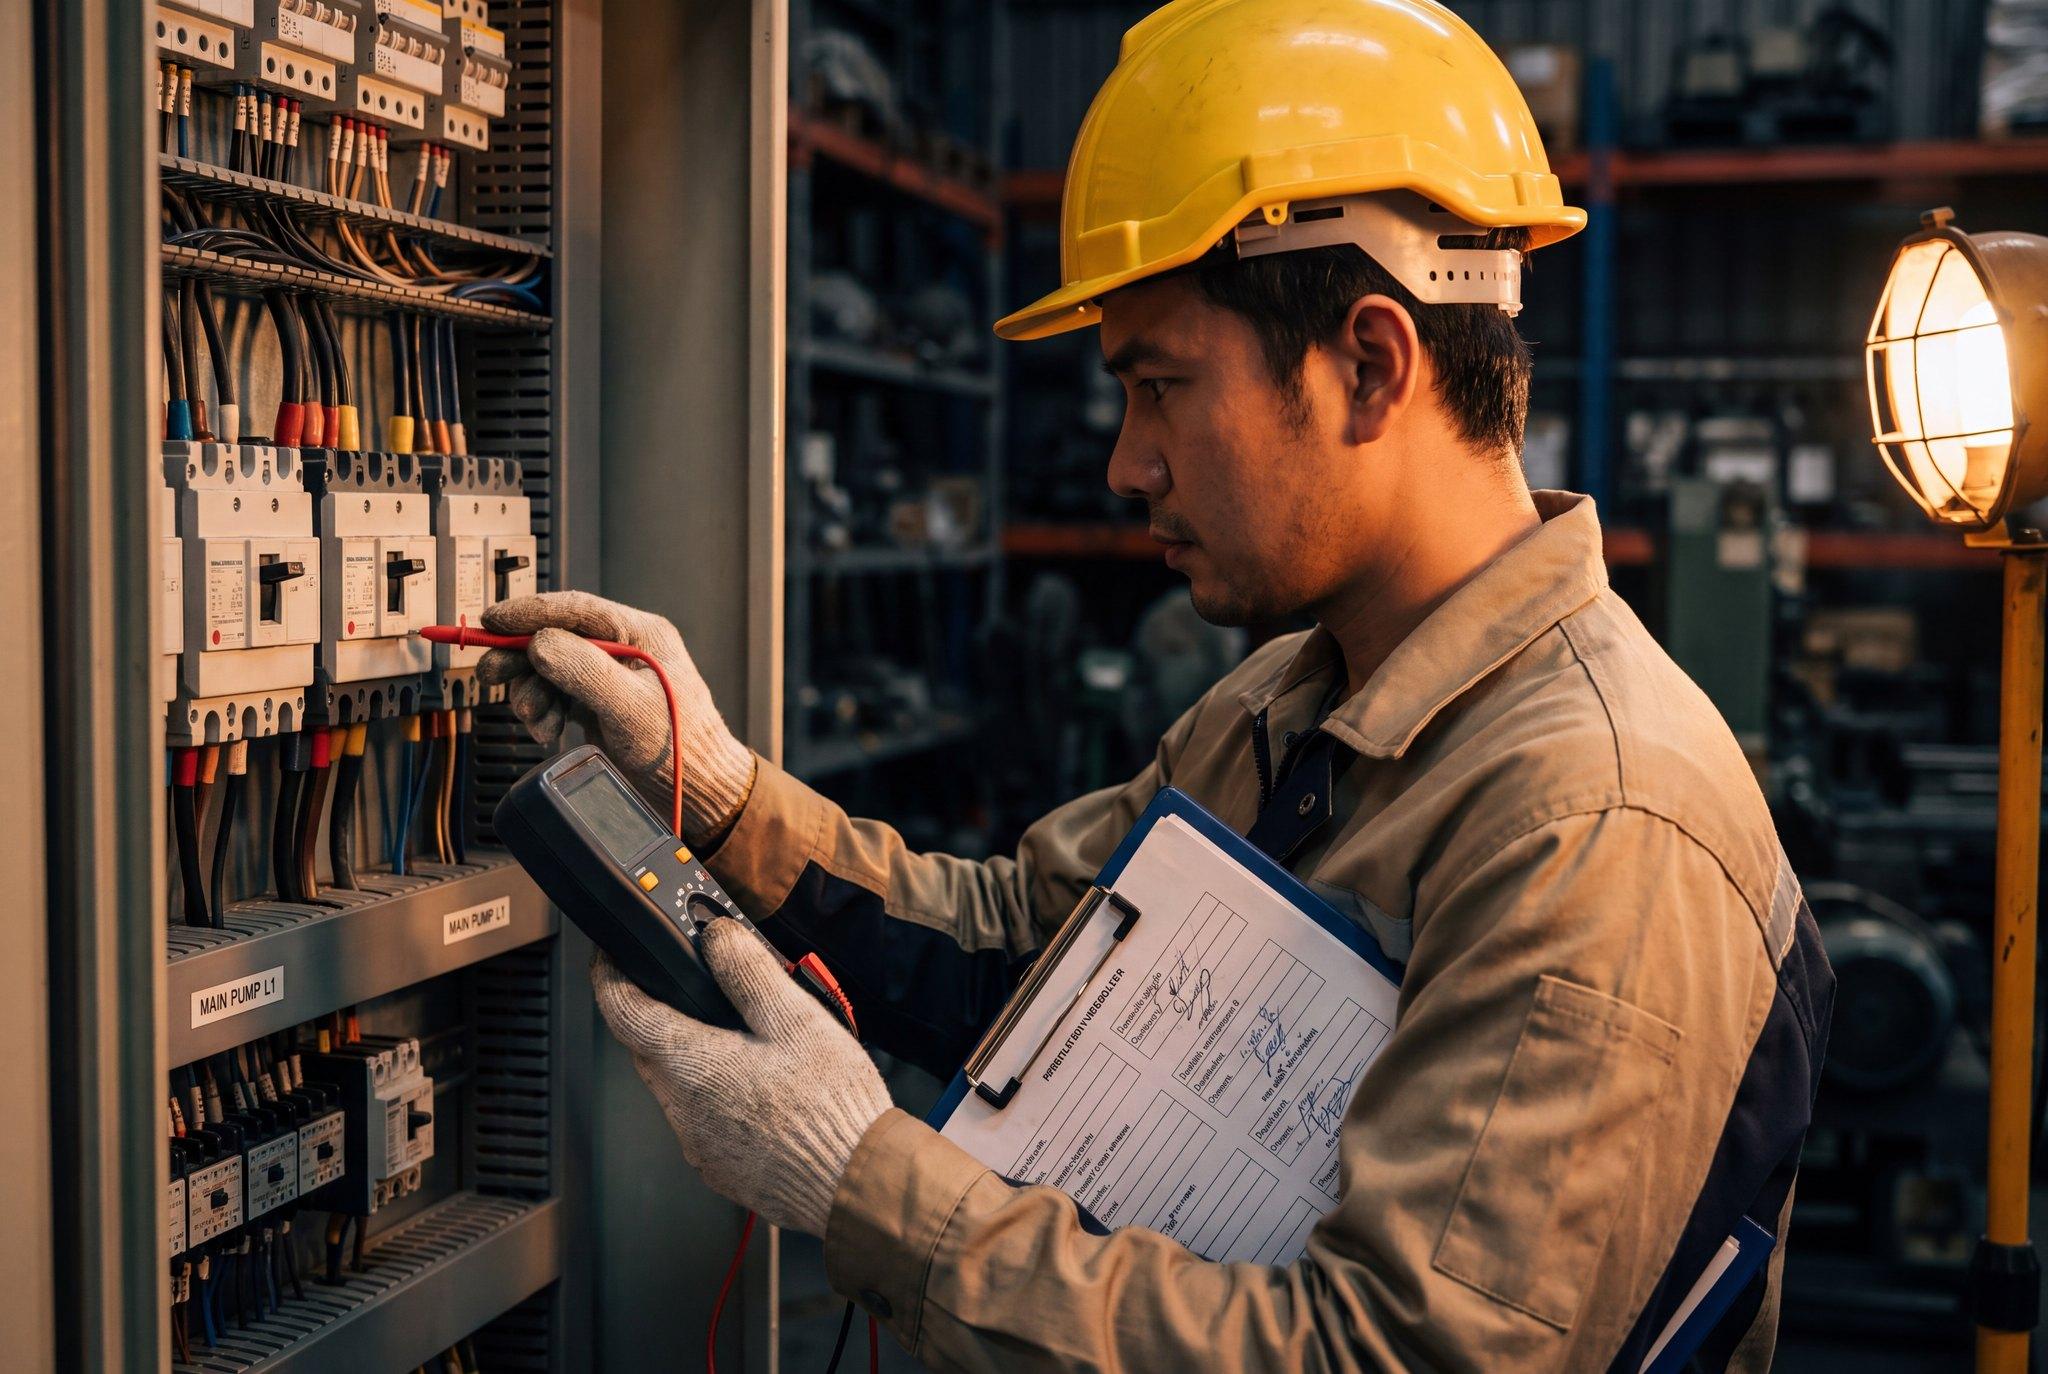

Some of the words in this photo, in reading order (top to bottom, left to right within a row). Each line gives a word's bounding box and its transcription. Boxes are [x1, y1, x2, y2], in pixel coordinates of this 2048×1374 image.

[449, 915, 469, 935] MAIN
[471, 909, 494, 928] PUMP
[496, 905, 504, 921] L1
[200, 992, 227, 1016] MAIN
[230, 982, 261, 1006] PUMP
[264, 977, 275, 996] L1
